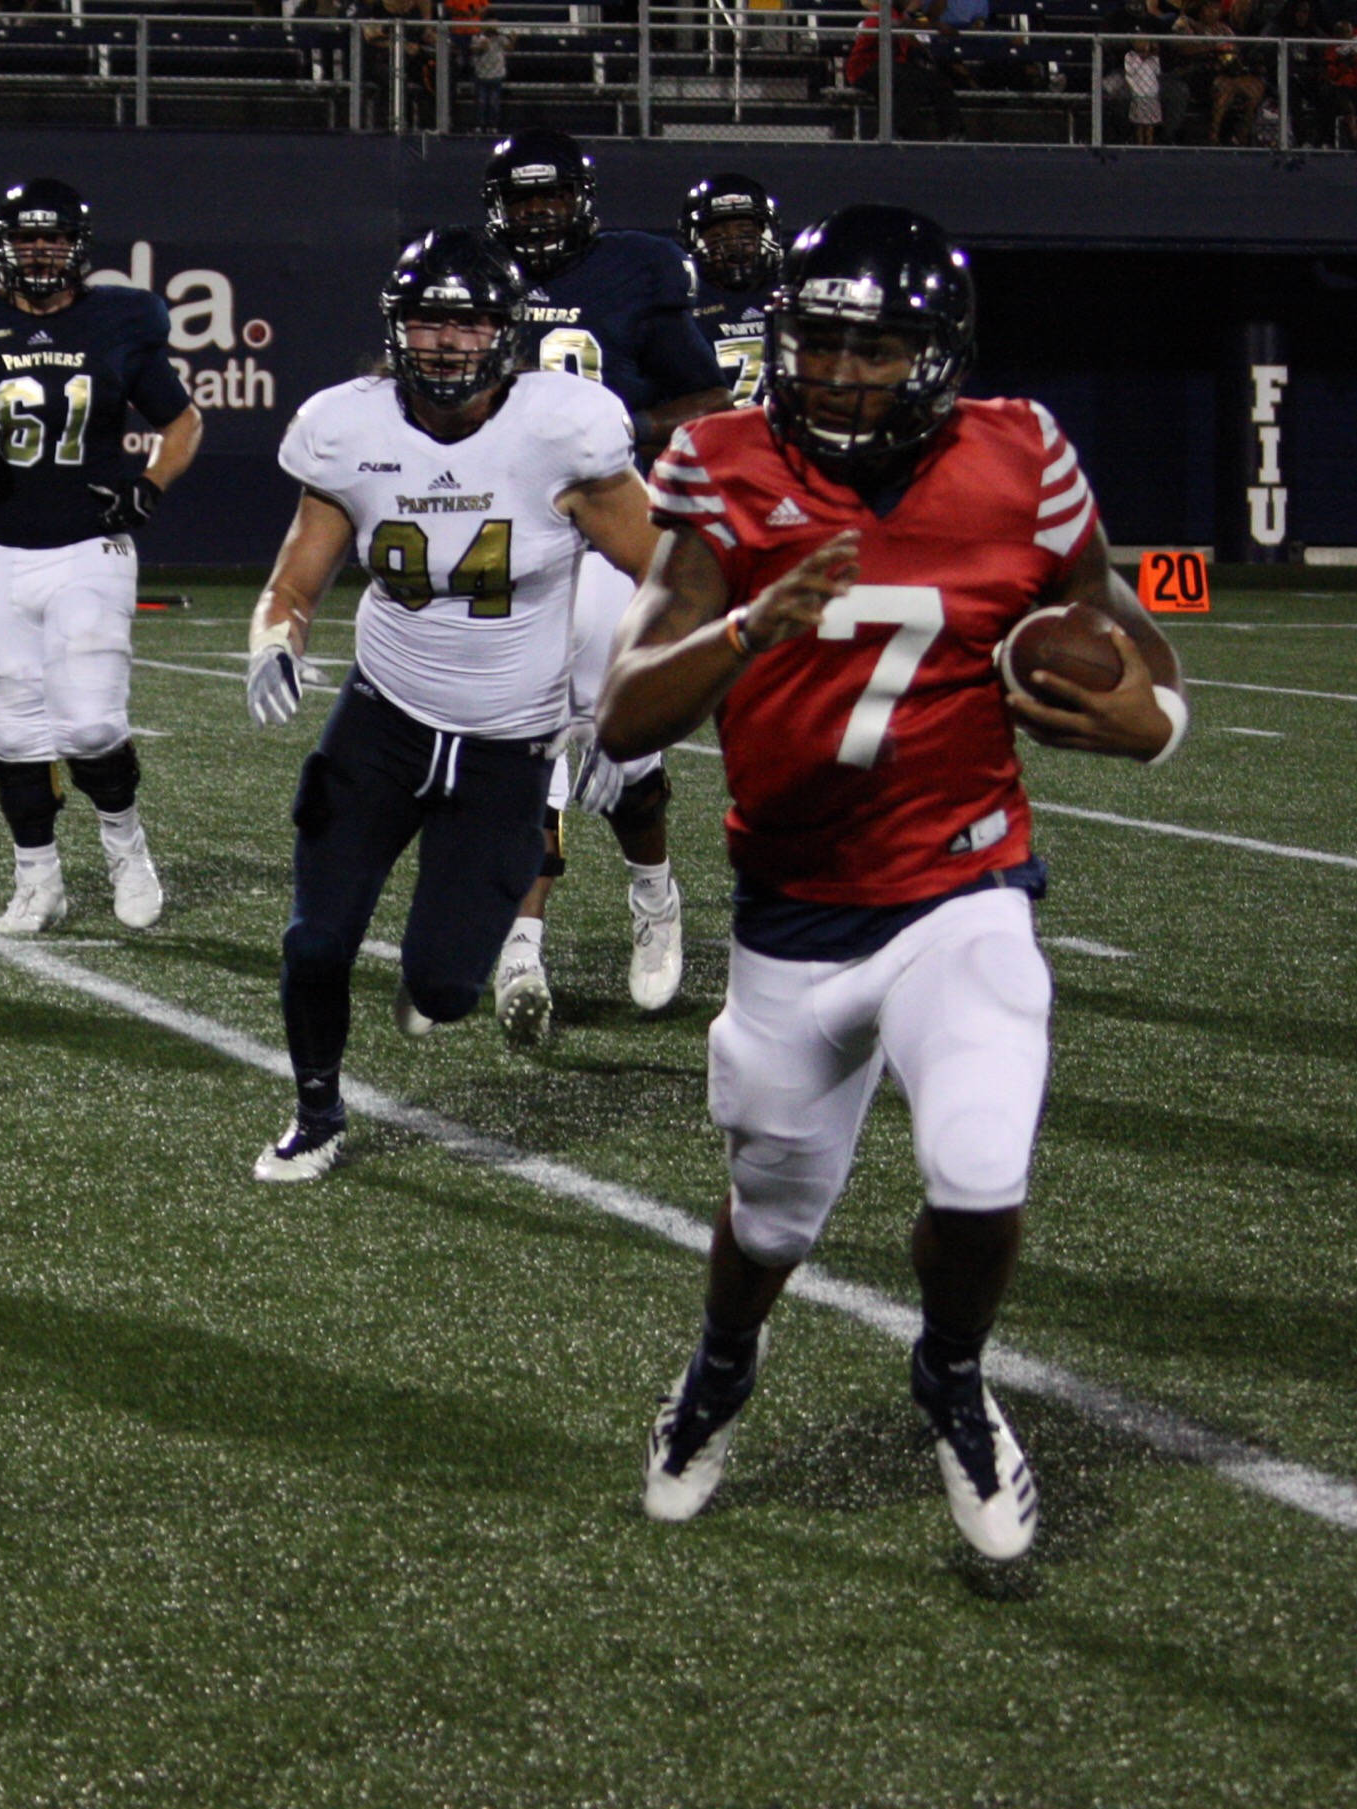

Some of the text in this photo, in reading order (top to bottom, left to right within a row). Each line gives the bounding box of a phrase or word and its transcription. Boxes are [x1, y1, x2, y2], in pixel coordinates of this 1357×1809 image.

[1, 351, 86, 371] PANTHERS
[1247, 364, 1289, 546] FIU
[395, 491, 495, 515] PANTHERS
[368, 518, 518, 619] 94
[1151, 553, 1204, 602] 20
[817, 584, 944, 769] 7
